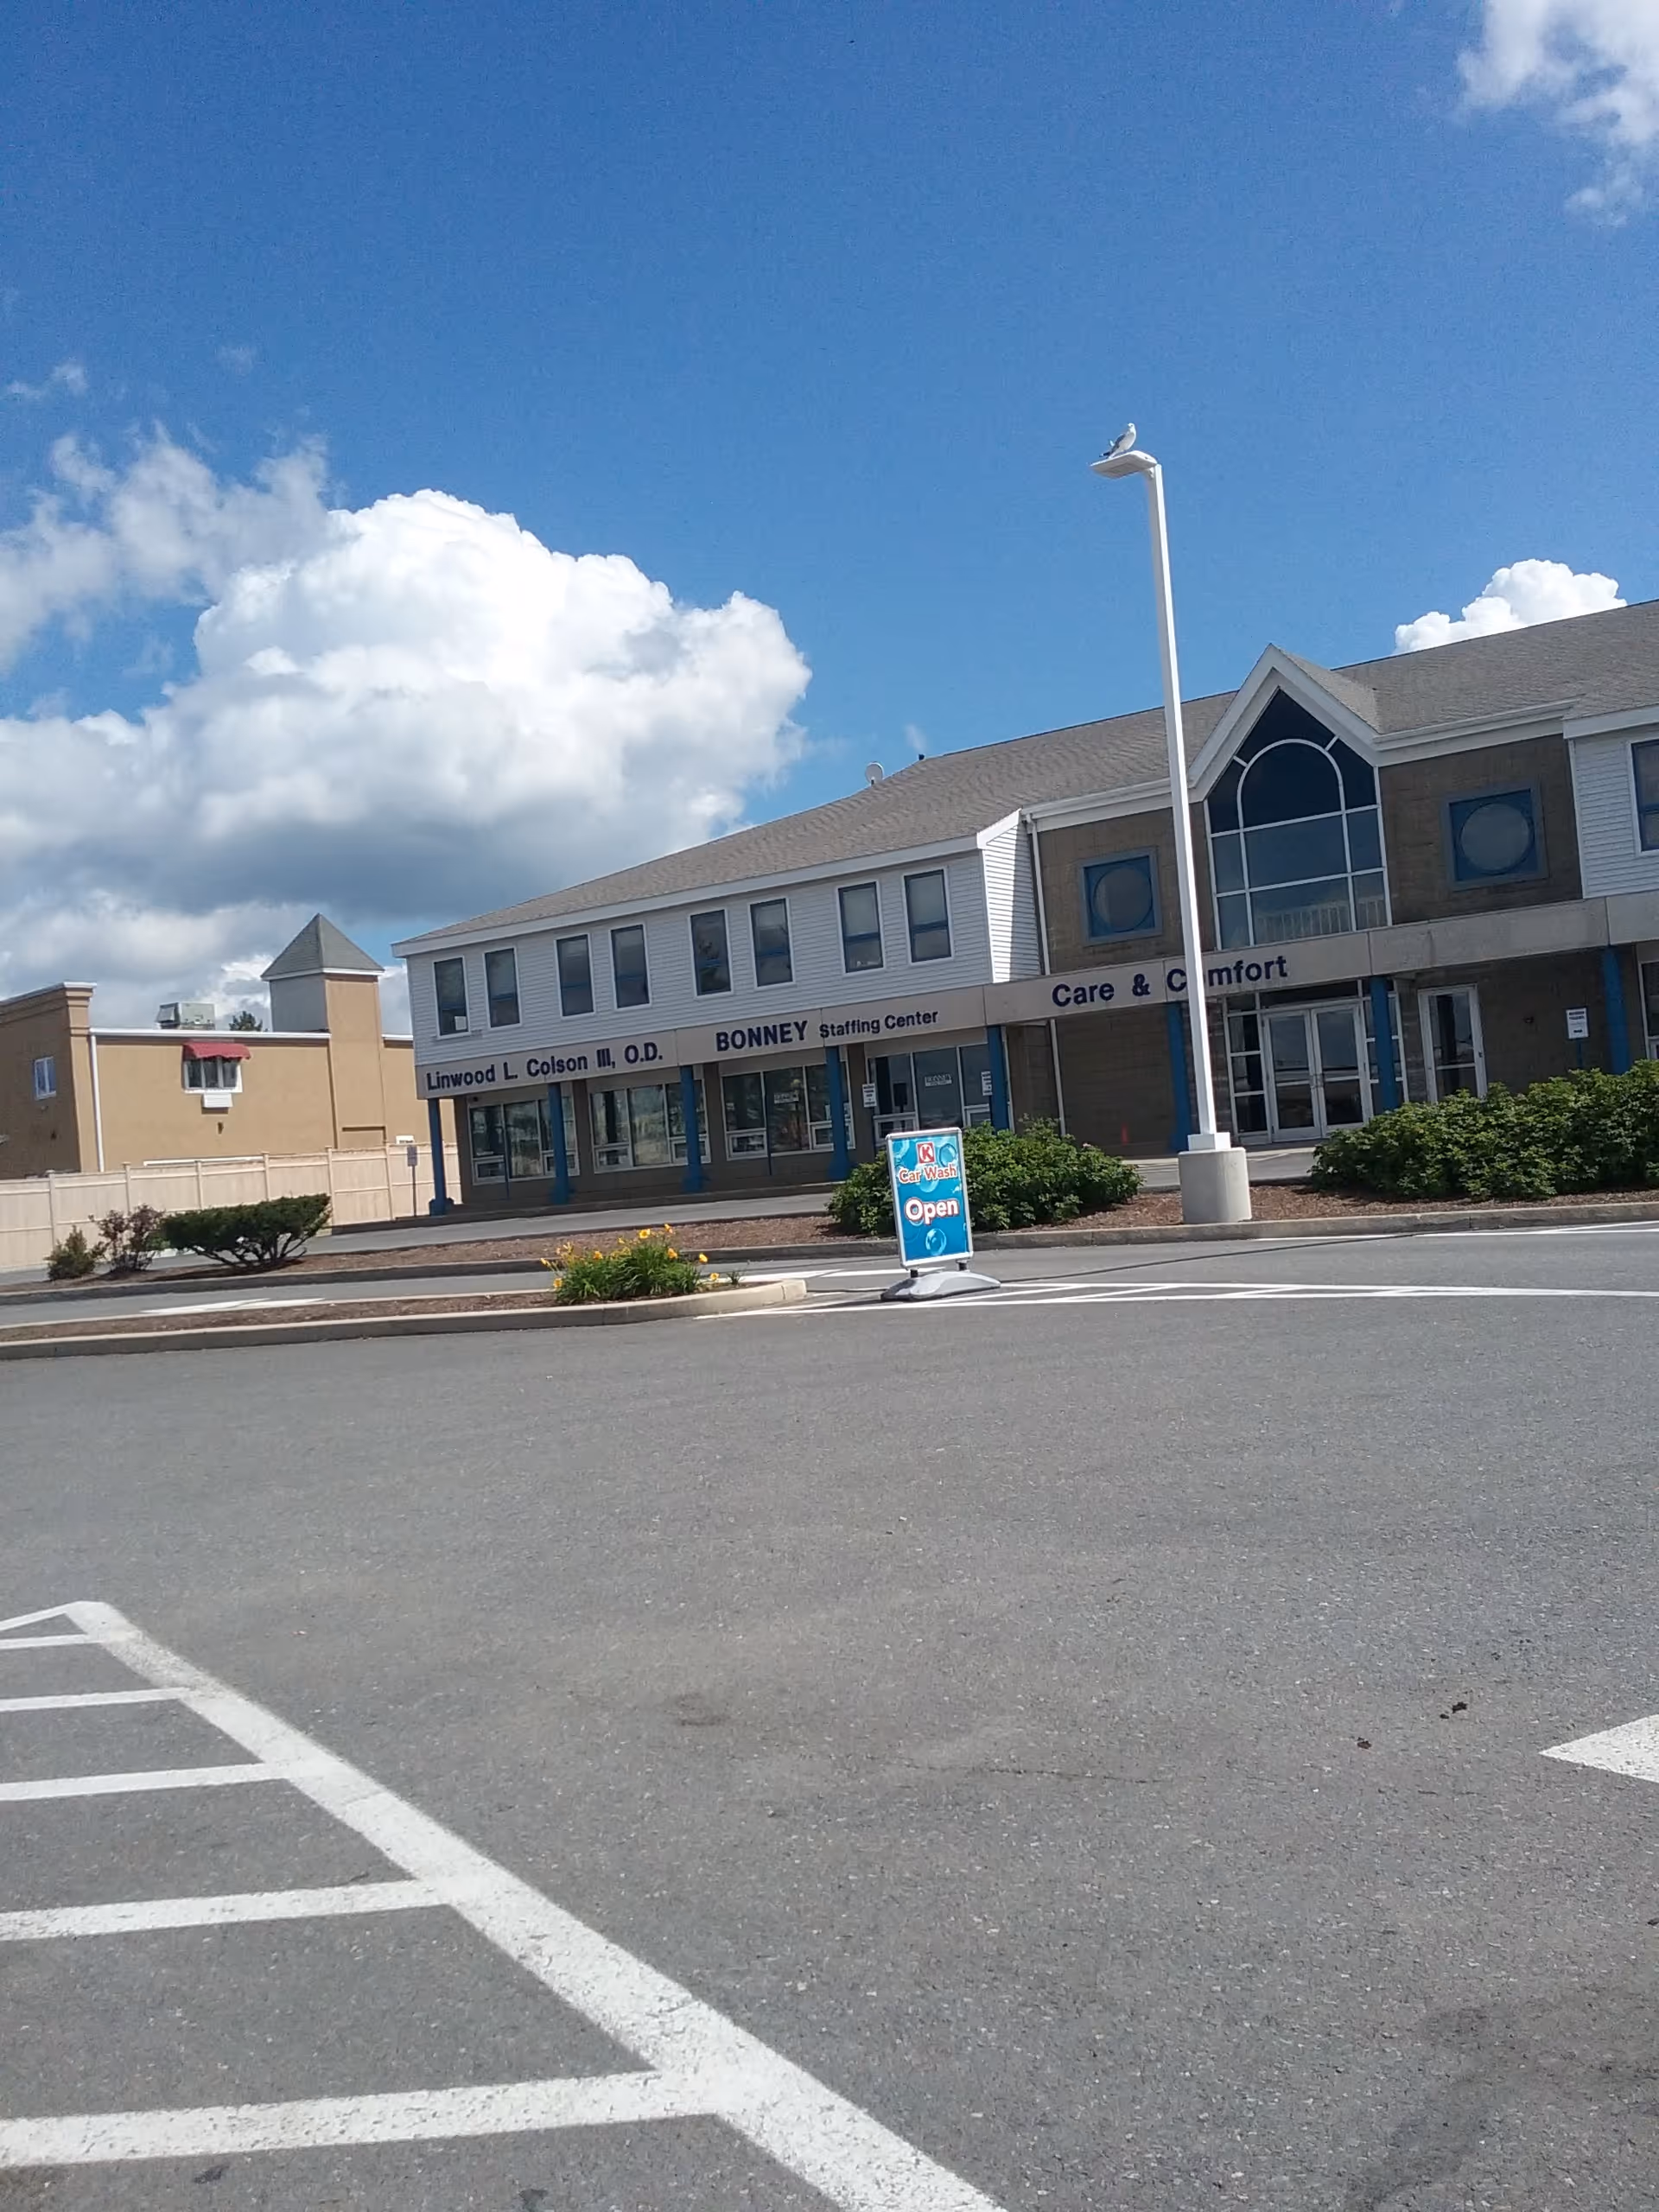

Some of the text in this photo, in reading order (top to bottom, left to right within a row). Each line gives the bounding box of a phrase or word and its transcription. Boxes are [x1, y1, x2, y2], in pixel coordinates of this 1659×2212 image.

[1052, 956, 1287, 1007] Care & Cmfort
[716, 1011, 938, 1052] BONNEY Staffing Center
[426, 1064, 495, 1090] Linwood
[504, 1062, 518, 1080] L.
[526, 1055, 588, 1077] Colson
[624, 1042, 663, 1065] O.D.
[899, 1164, 957, 1183] Car Wash
[906, 1198, 959, 1224] Open
